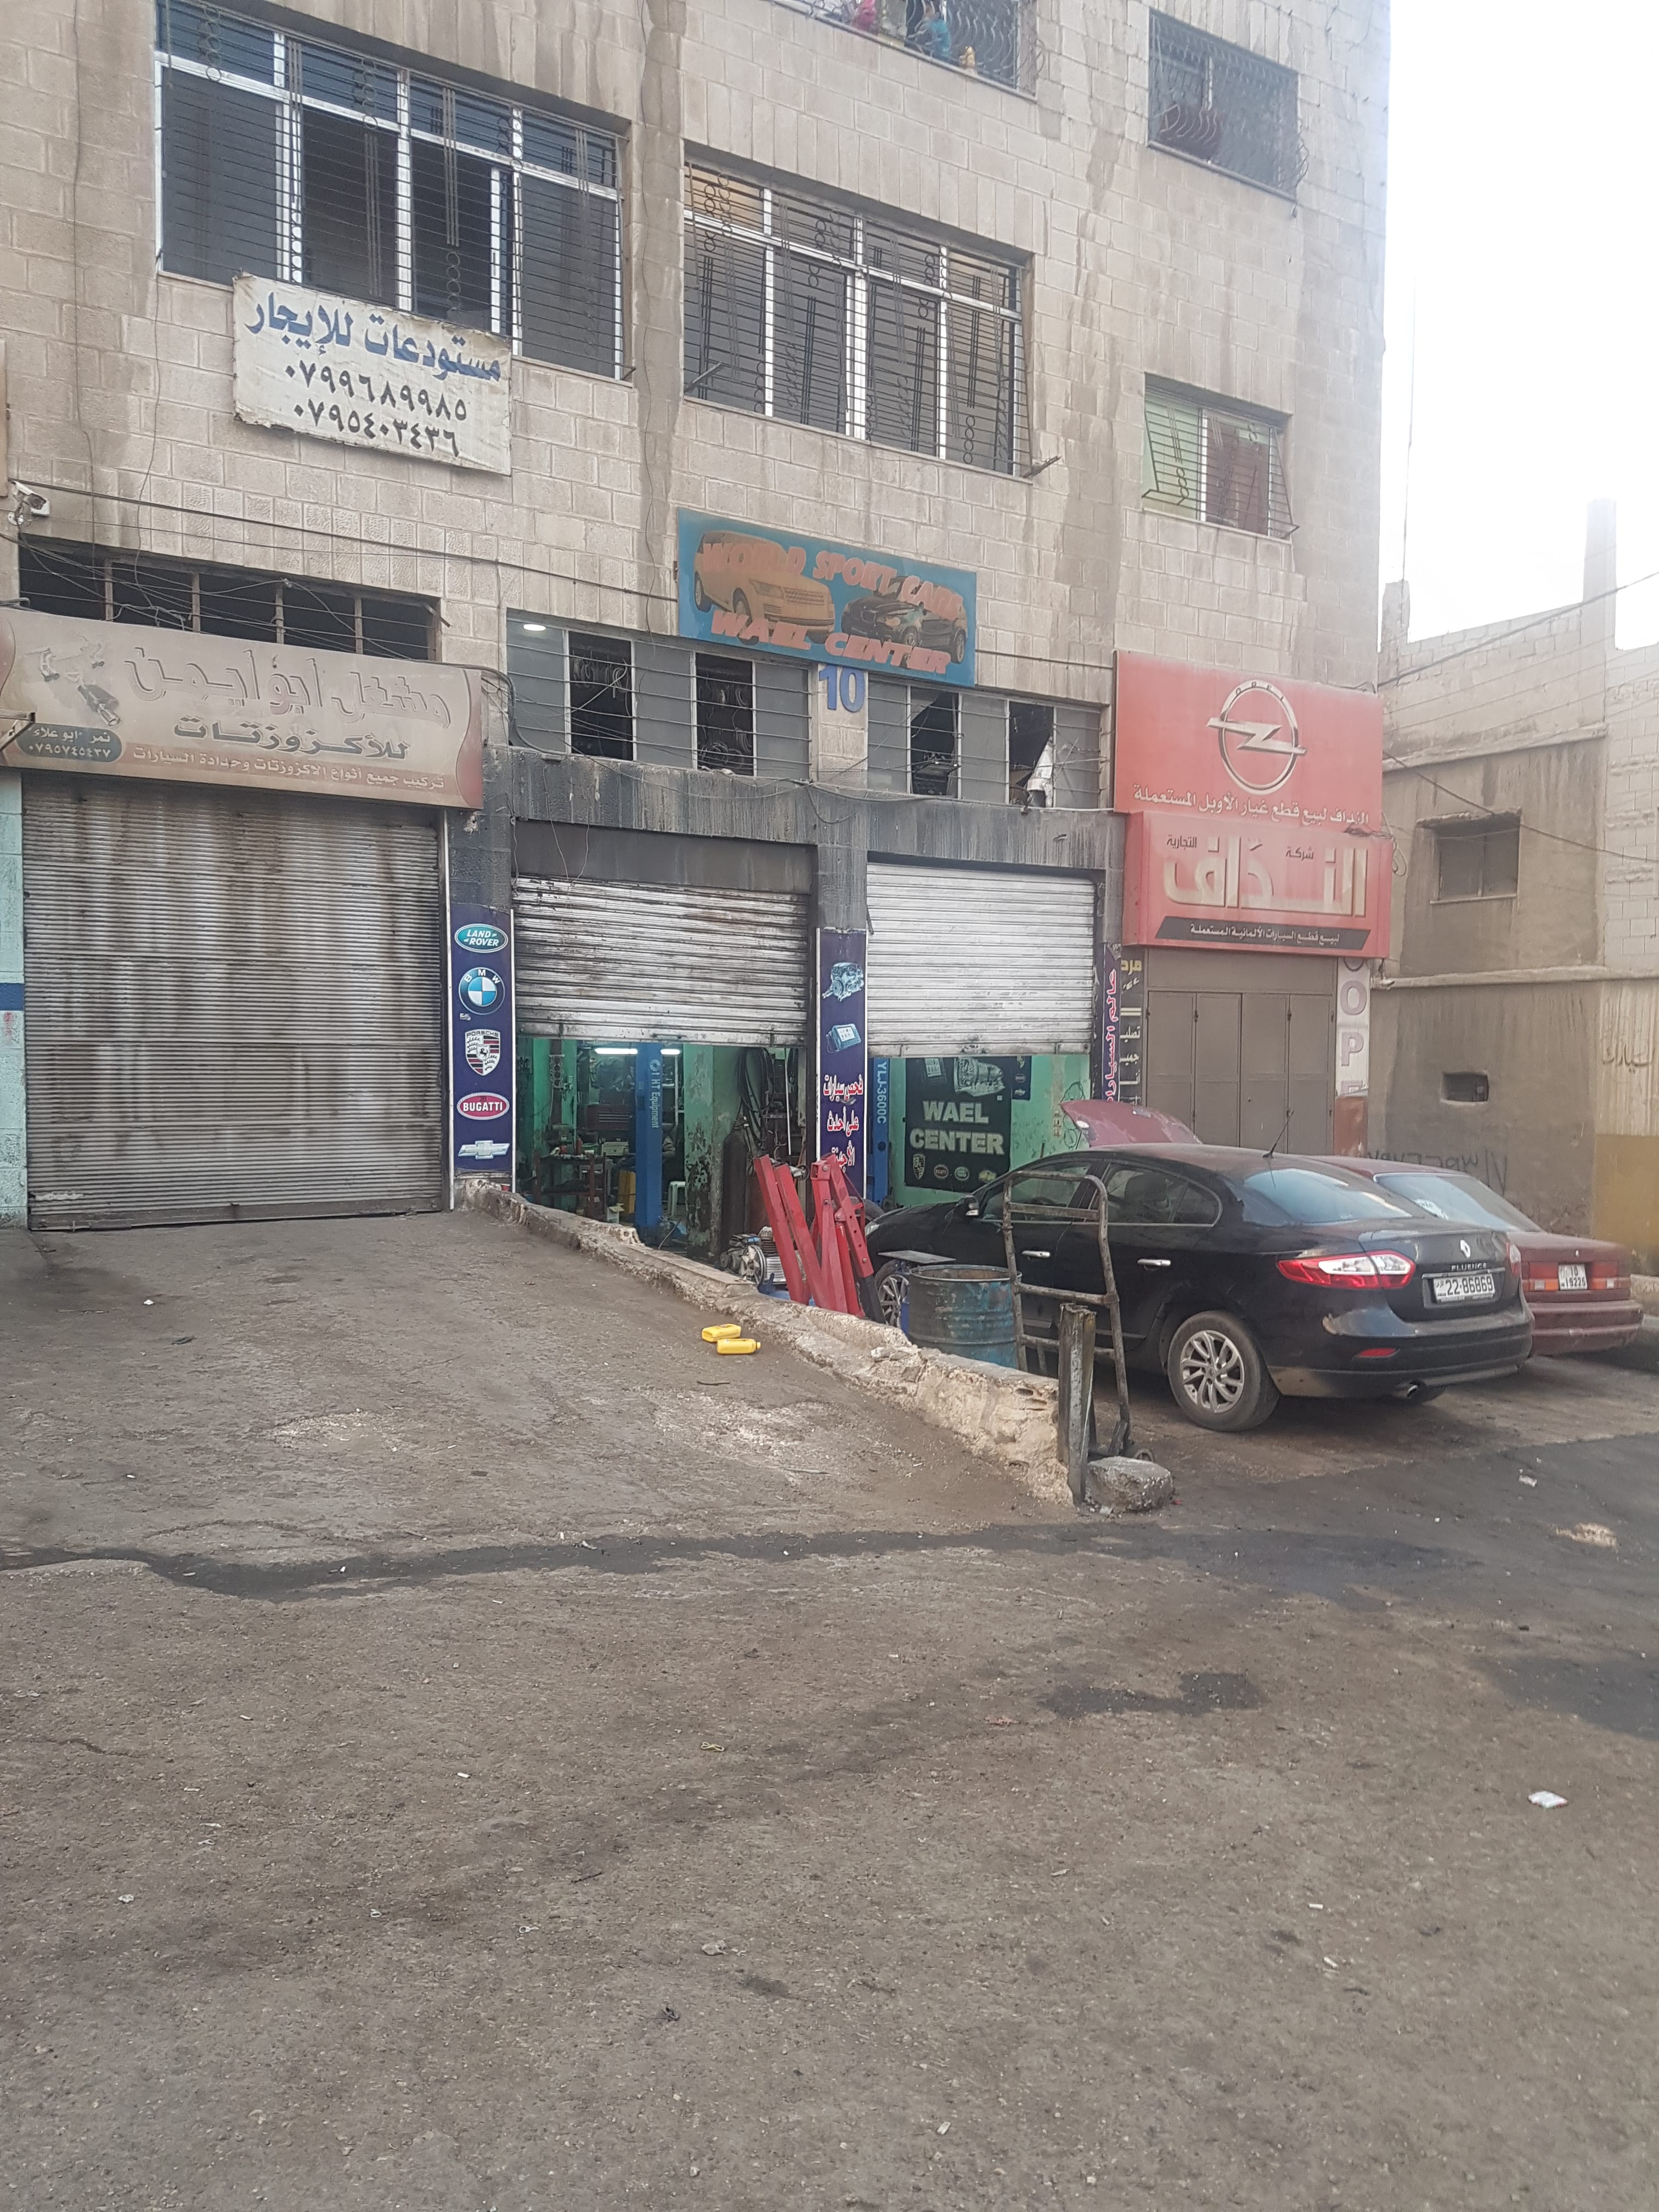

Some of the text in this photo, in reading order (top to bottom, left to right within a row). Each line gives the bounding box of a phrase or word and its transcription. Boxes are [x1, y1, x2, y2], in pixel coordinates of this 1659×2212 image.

[244, 291, 501, 383] مستودعات للإيجار
[285, 359, 467, 421] ٠٧٩٩٦٨٩٩٨٥
[294, 398, 459, 458] ٠٧٩٥٤٠٣٤٣٦
[702, 543, 806, 577] WORLD
[812, 550, 897, 595] SPORT
[711, 611, 952, 674] WAEL CENTER
[819, 664, 865, 713] 10
[33, 727, 58, 738] علاء
[133, 746, 194, 764] السيارات
[366, 772, 399, 786] جميع
[403, 776, 444, 790] تركيب
[1133, 784, 1196, 808] المستعملة
[1241, 797, 1268, 819] غيار
[1271, 800, 1300, 822] قطع
[1166, 834, 1198, 849] التجارية
[1285, 847, 1314, 861] شركة
[466, 929, 491, 938] LAND
[469, 938, 499, 947] ROVER
[464, 969, 500, 984] BMW
[823, 1074, 864, 1102] فحص سيارات
[877, 1061, 888, 1124] YLJ-3600C
[463, 1102, 503, 1112] BUGATTI
[649, 1091, 661, 1128] Equipment
[922, 1100, 990, 1124] WAEL
[845, 1109, 860, 1137] على
[910, 1127, 1005, 1155] CENTER
[1451, 1262, 1487, 1272] FLUENCE
